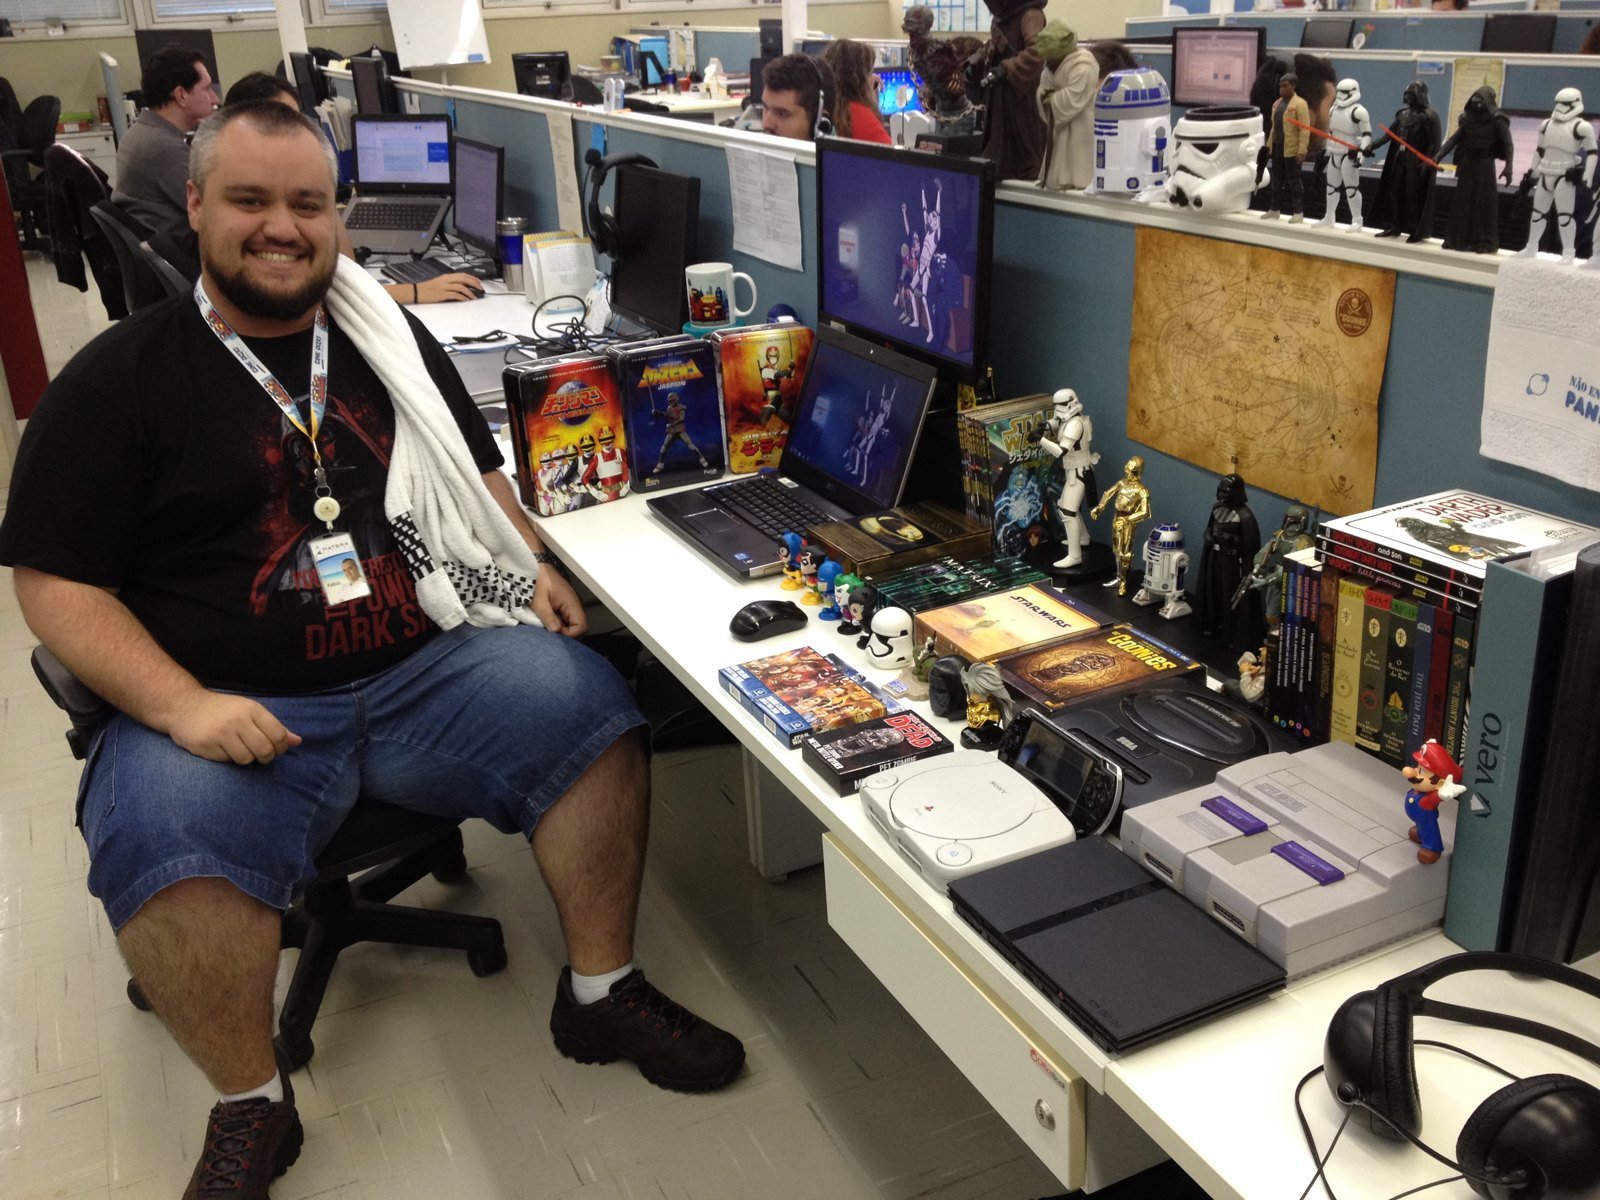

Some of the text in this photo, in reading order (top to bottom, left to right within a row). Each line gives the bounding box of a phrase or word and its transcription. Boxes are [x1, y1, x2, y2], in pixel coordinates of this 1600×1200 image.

[657, 380, 687, 391] JASPION
[1569, 375, 1588, 392] NÃO
[1565, 390, 1600, 425] PAN
[1416, 495, 1488, 516] DARTH
[1446, 502, 1514, 523] VADER
[943, 557, 992, 589] MATRIX
[1010, 594, 1072, 629] STAR WARS
[306, 606, 398, 661] DARK
[1412, 672, 1425, 736] THE JEDI PATH
[884, 714, 934, 748] DEAD
[1475, 712, 1503, 785] vero
